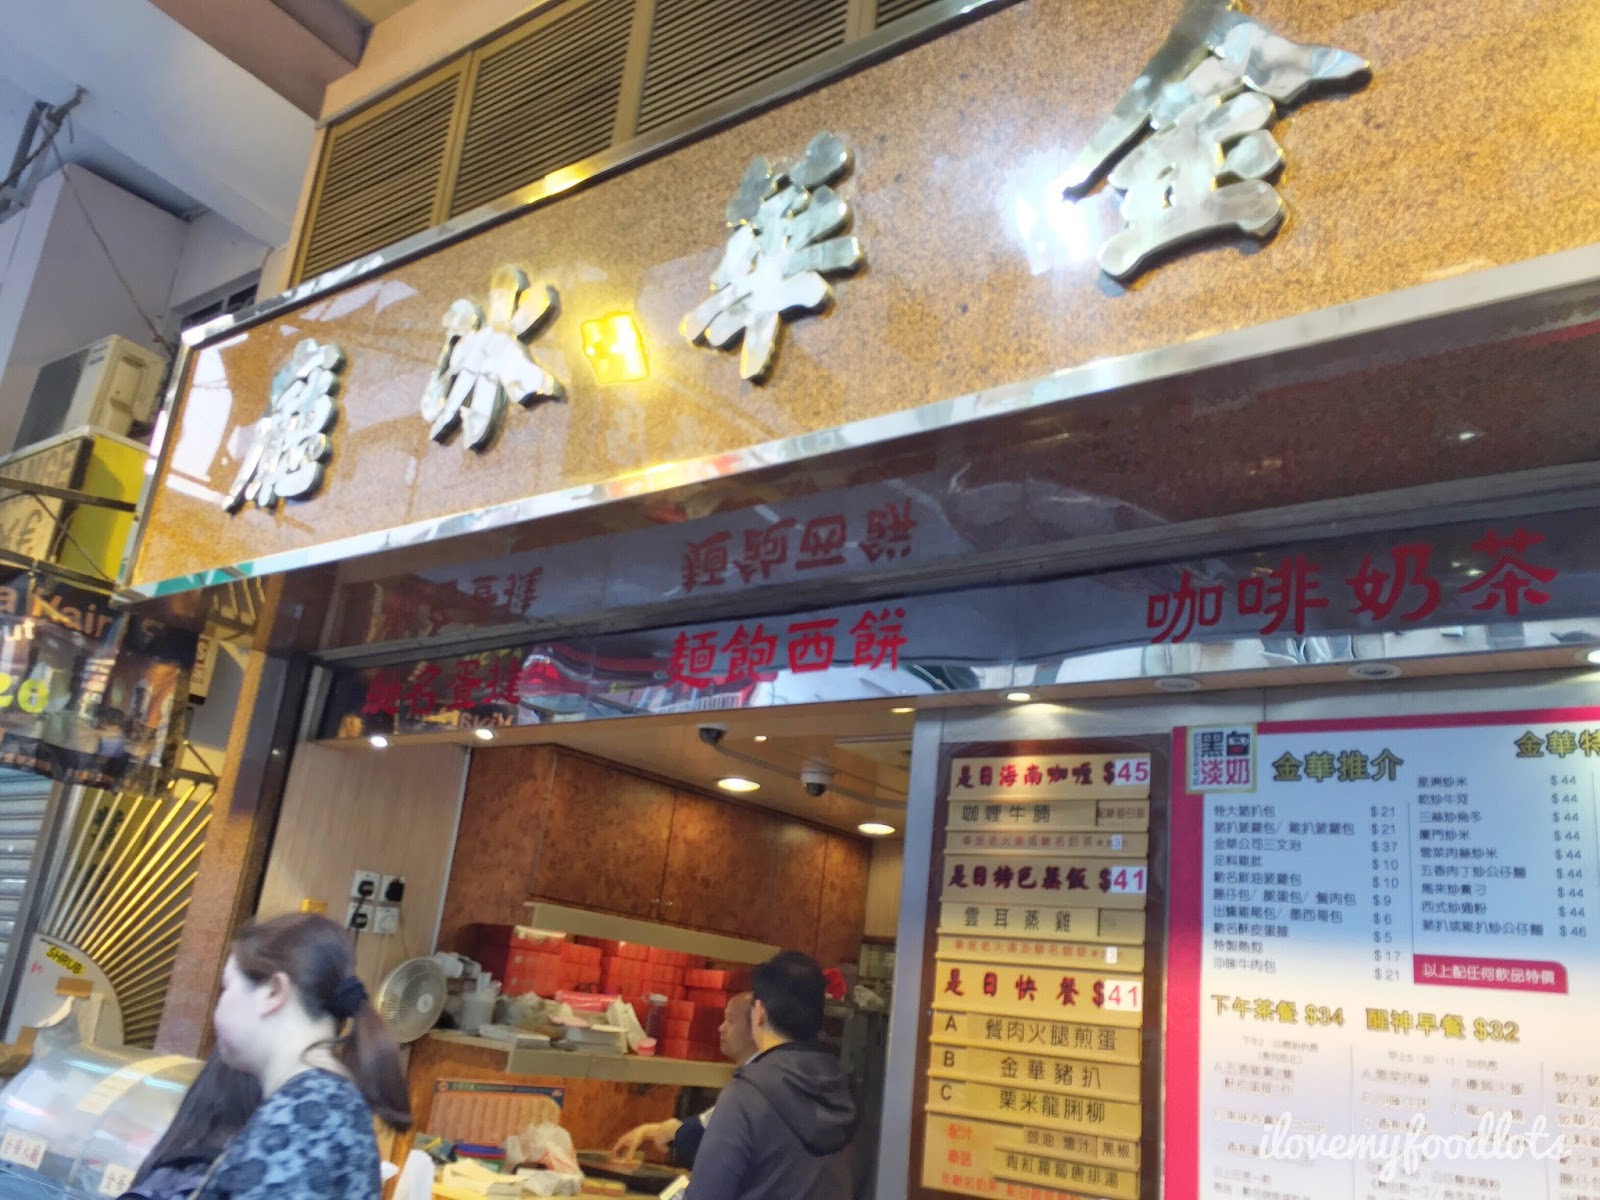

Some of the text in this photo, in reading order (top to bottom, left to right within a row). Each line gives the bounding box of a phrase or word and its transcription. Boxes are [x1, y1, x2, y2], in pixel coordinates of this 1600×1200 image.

[1147, 527, 1558, 643] 咖啡奶茶
[663, 607, 907, 687] 麵飽西餅
[956, 760, 1149, 788] 是日海南咖喱 $45
[1272, 748, 1404, 782] 金華推介
[1099, 864, 1144, 893] $41
[965, 906, 1071, 932] 雲耳蒸雞
[944, 968, 1138, 1008] 是日快餐 $41
[1211, 994, 1345, 1027] 下午茶餐 $34
[1365, 1007, 1520, 1043] 醒神早餐 $32
[945, 1016, 1117, 1051] A 餐肉火腿煎蛋
[944, 1051, 1101, 1090] B 金華豬扒
[941, 1085, 952, 1101] C
[1102, 1142, 1131, 1159] 黑椒
